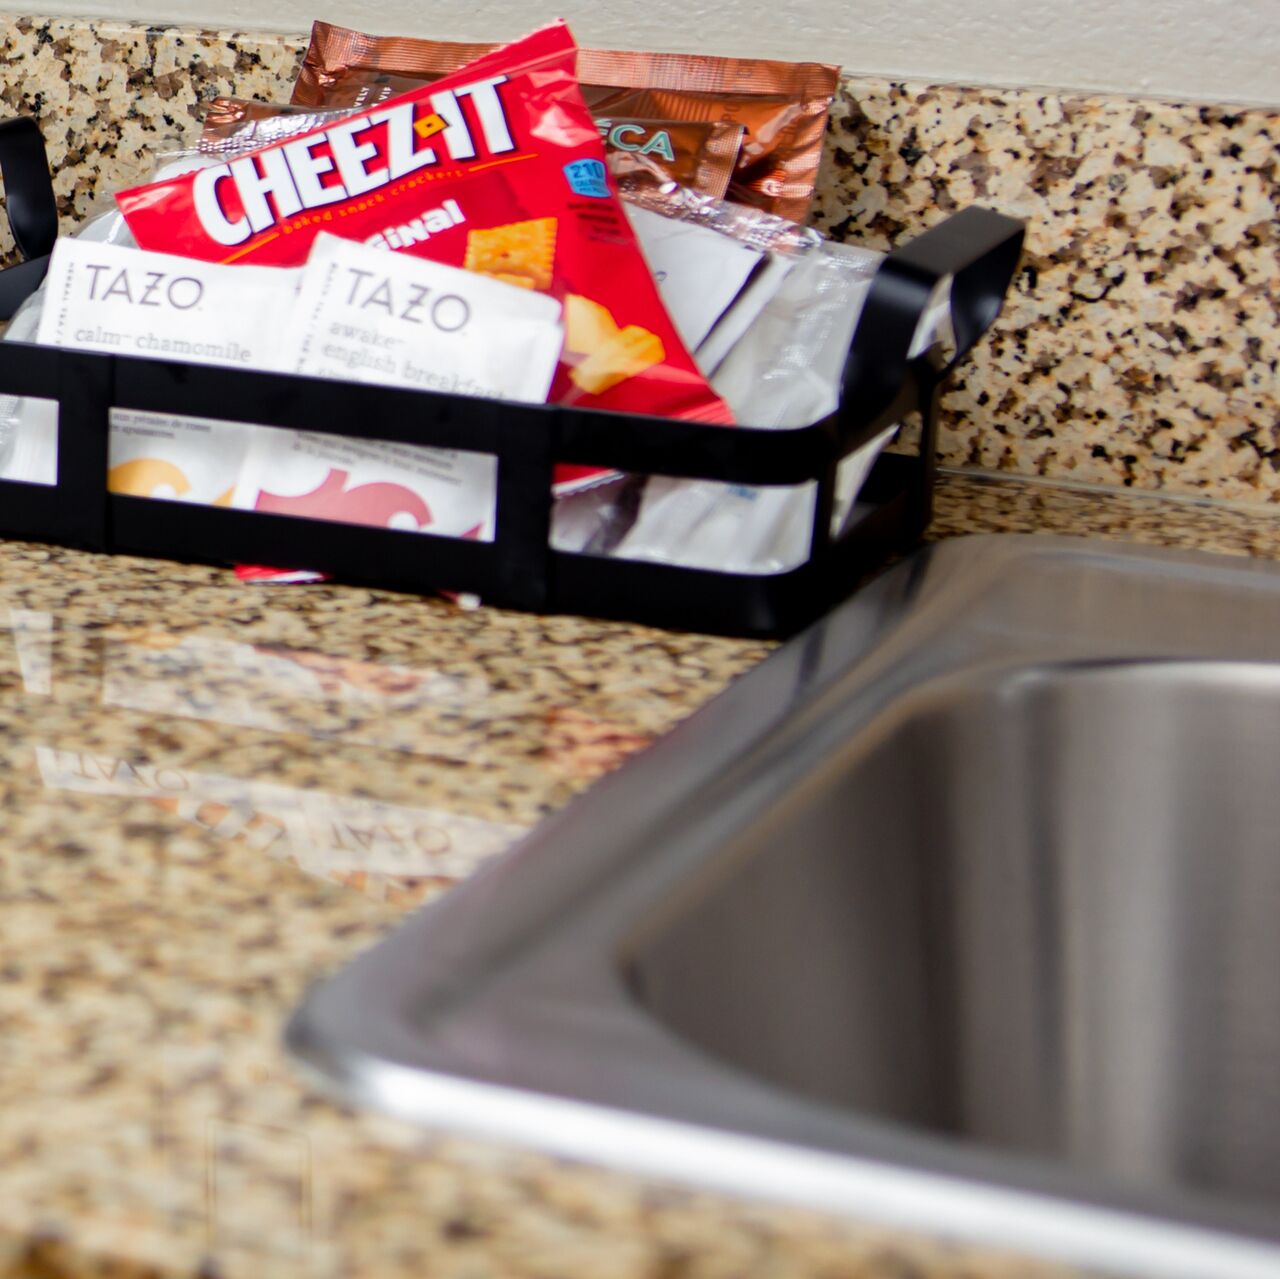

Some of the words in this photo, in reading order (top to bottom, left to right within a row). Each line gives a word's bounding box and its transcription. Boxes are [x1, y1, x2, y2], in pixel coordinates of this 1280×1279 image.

[283, 211, 333, 234] baked
[339, 194, 385, 218] snack
[391, 170, 463, 196] crackers
[86, 264, 204, 310] TAZO
[346, 267, 470, 333] TAZO
[135, 333, 252, 363] chamomile
